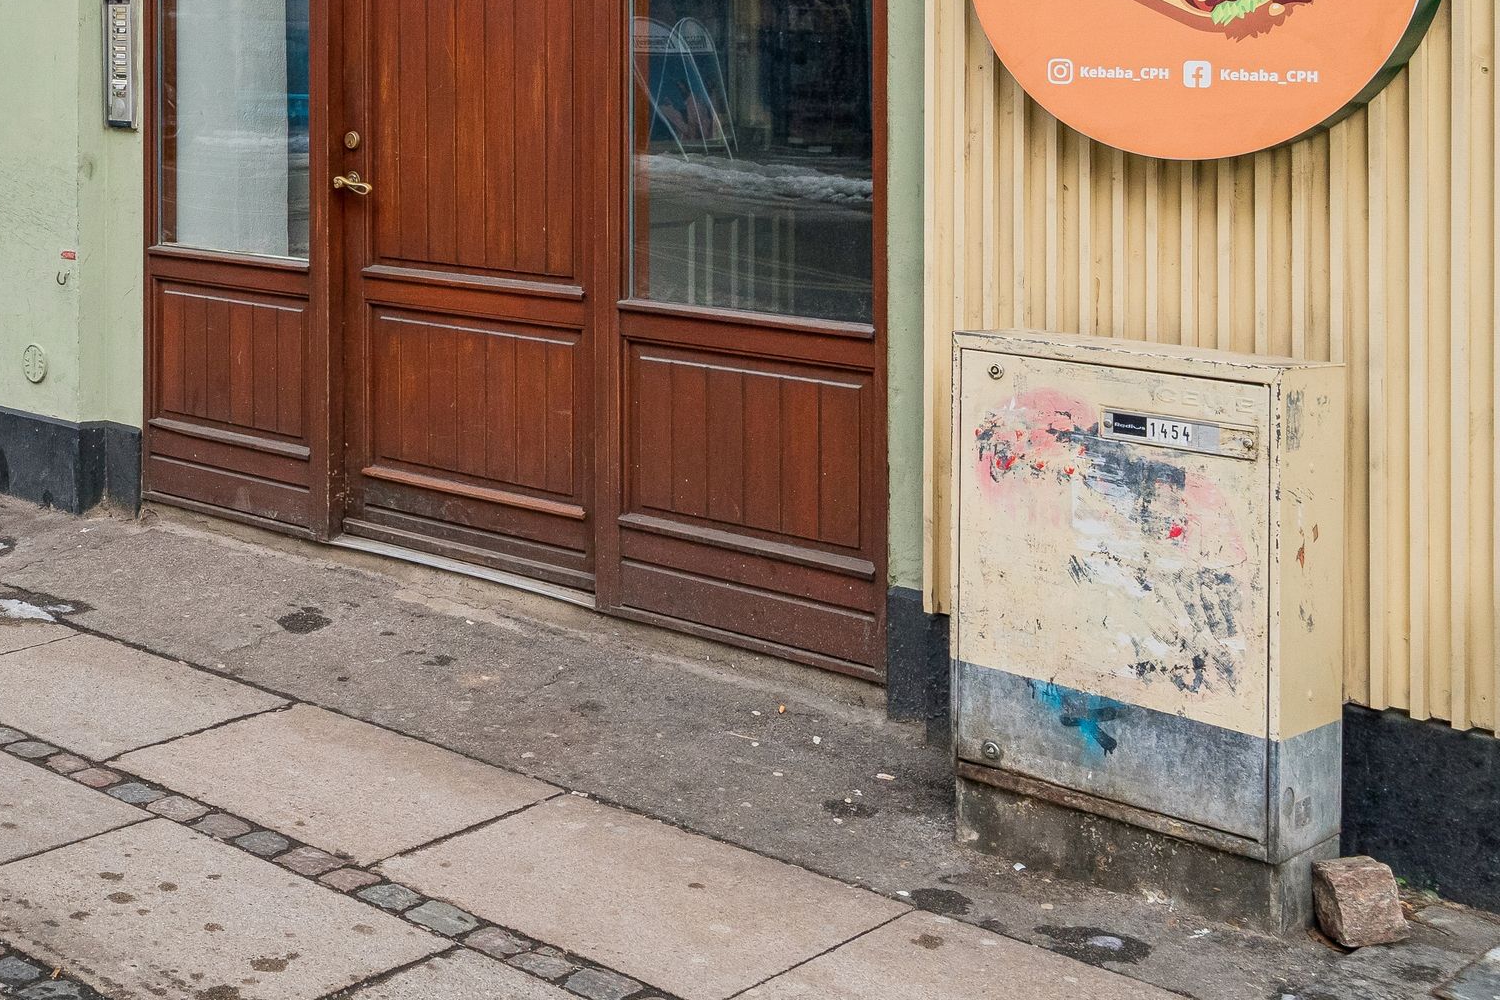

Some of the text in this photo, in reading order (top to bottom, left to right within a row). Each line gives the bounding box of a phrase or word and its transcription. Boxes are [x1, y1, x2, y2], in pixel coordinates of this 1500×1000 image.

[1080, 66, 1170, 81] Kebaba_CPH
[1220, 68, 1319, 85] Kebaba_CPH
[1150, 422, 1190, 441] 1454
